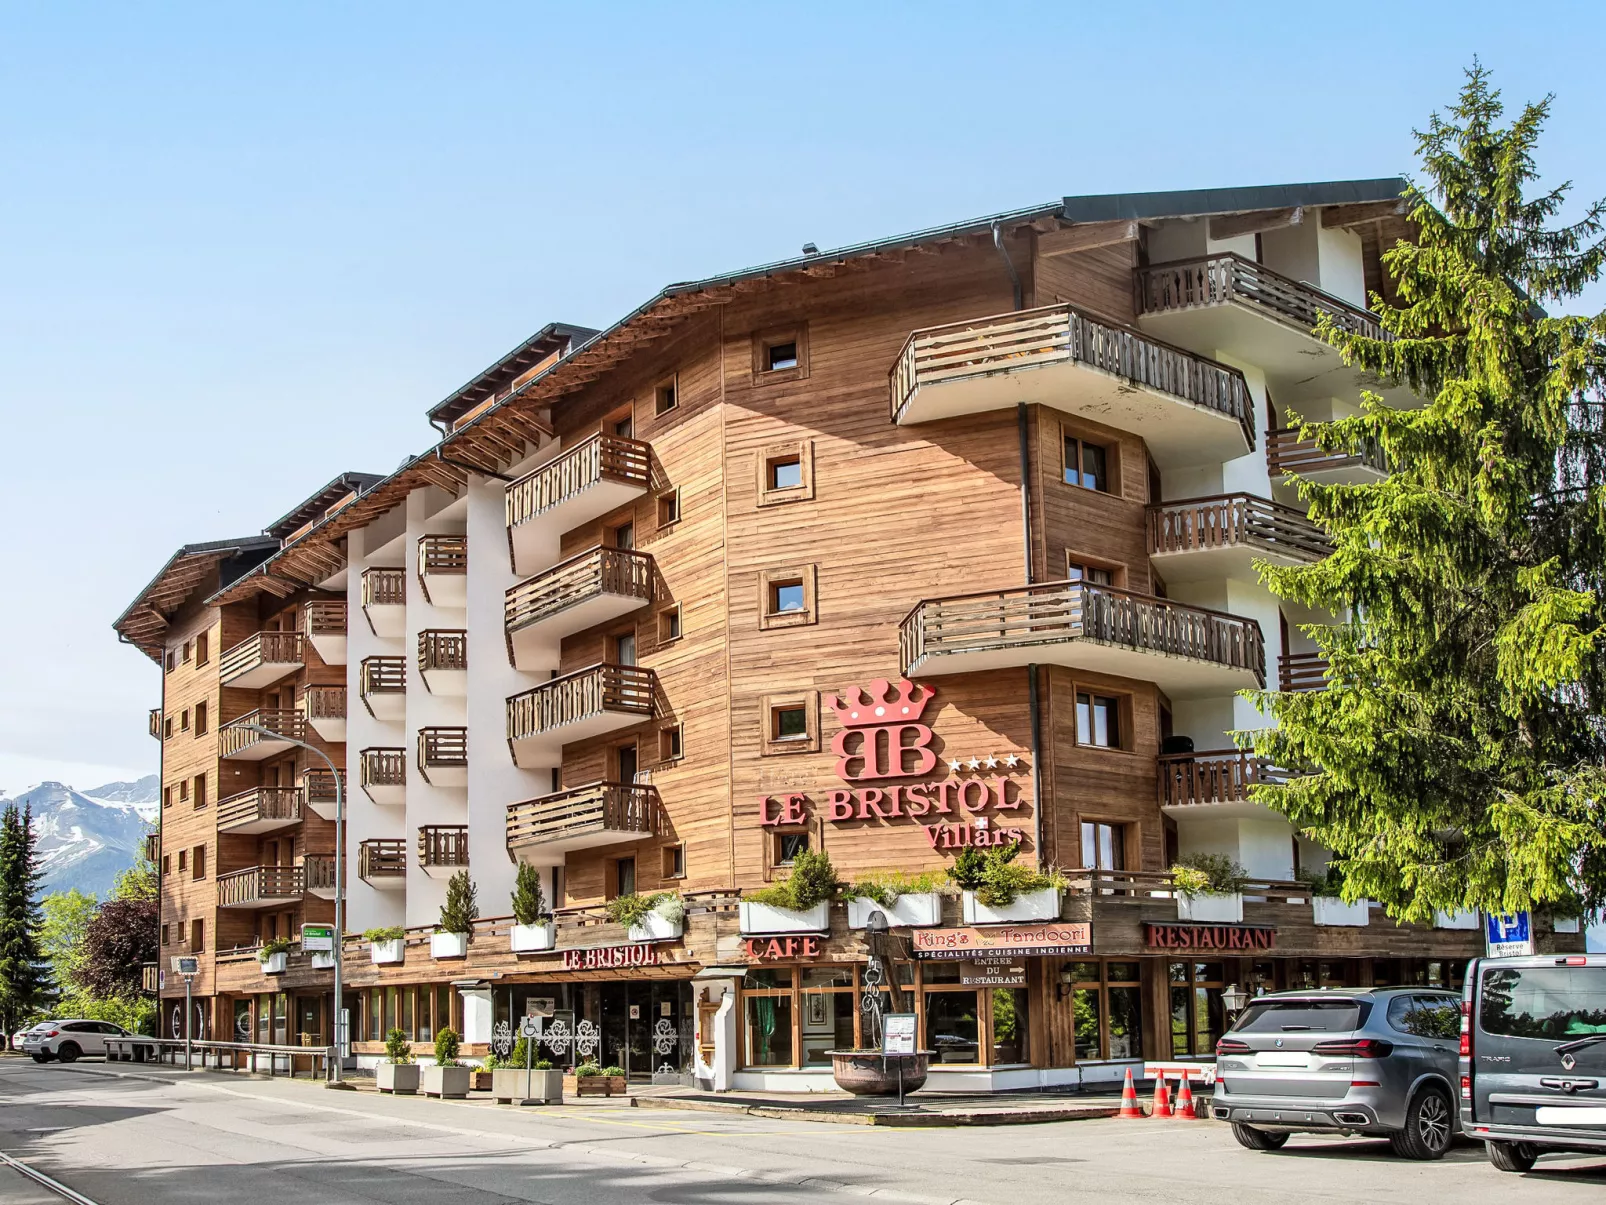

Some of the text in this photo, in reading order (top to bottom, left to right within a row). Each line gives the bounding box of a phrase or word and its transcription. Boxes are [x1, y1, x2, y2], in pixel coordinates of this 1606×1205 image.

[757, 776, 1022, 826] LE BRISTOL
[922, 823, 1023, 849] Villars
[1500, 911, 1518, 939] P
[746, 936, 820, 959] CAFE
[918, 928, 1085, 947] King's Tandoori
[1148, 926, 1277, 949] RESTAURANT
[563, 944, 656, 970] LE BRISTOL
[918, 946, 1088, 958] SPÉCIALITÉS CUISINE INDIENNE
[962, 976, 1024, 985] RESTAURANT
[986, 967, 1000, 975] DU
